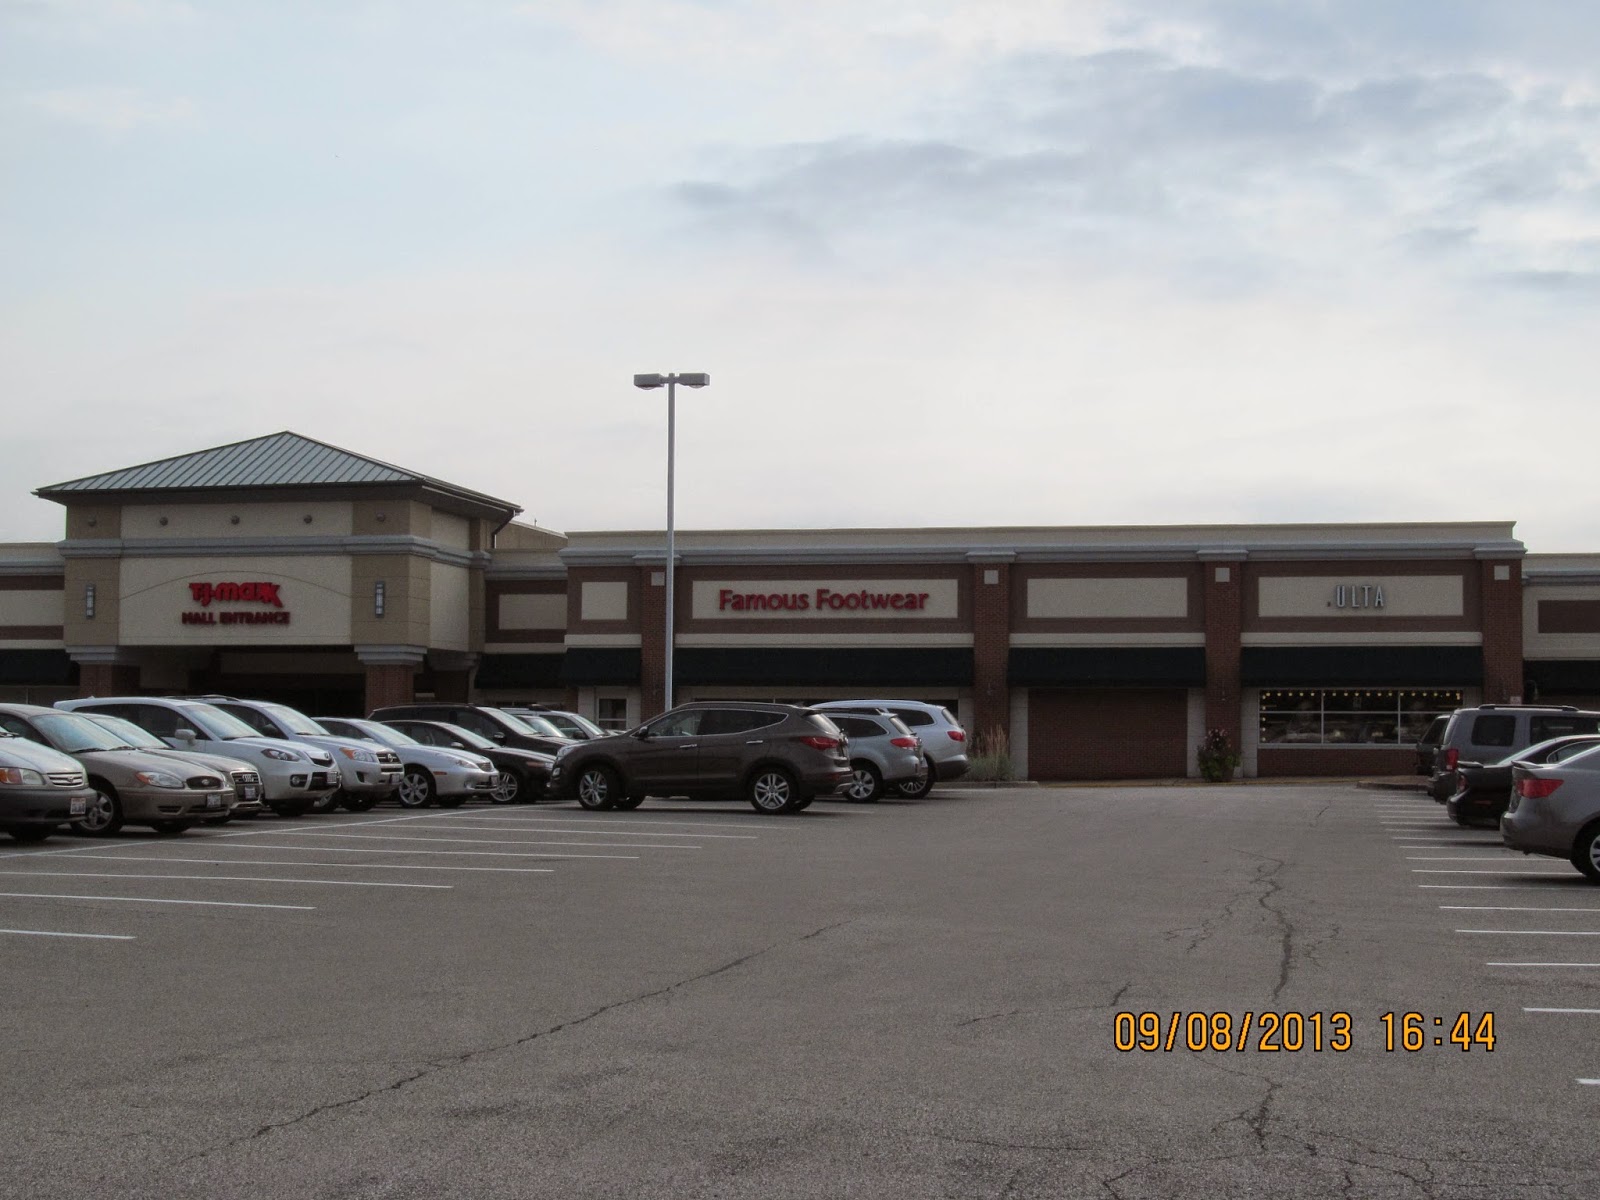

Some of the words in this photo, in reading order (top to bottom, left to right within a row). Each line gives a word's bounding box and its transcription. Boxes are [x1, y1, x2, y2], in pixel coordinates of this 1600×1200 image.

[719, 589, 809, 610] Famous
[816, 589, 929, 610] Footwear
[1336, 585, 1384, 607] ULTA
[182, 612, 216, 624] MALL
[220, 612, 290, 624] ENTRANCE
